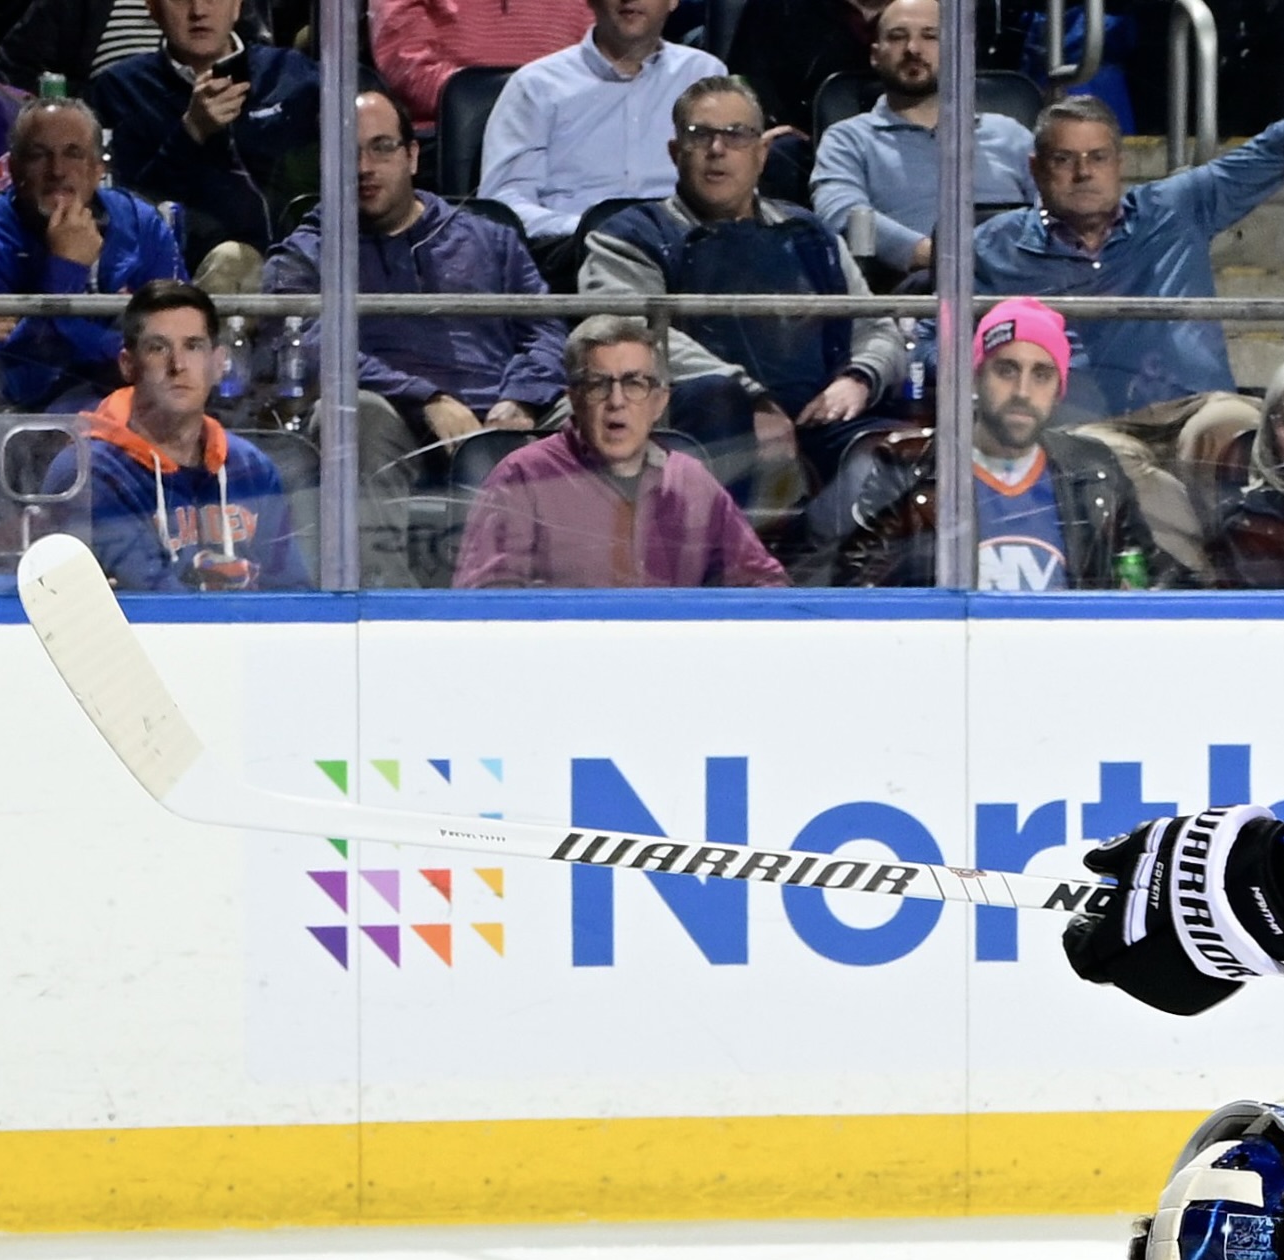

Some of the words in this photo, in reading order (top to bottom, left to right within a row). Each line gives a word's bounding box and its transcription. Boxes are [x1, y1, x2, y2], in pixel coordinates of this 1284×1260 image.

[551, 832, 920, 895] WARRIOR
[1148, 861, 1165, 910] COVERT
[1170, 806, 1264, 979] WARRIOR
